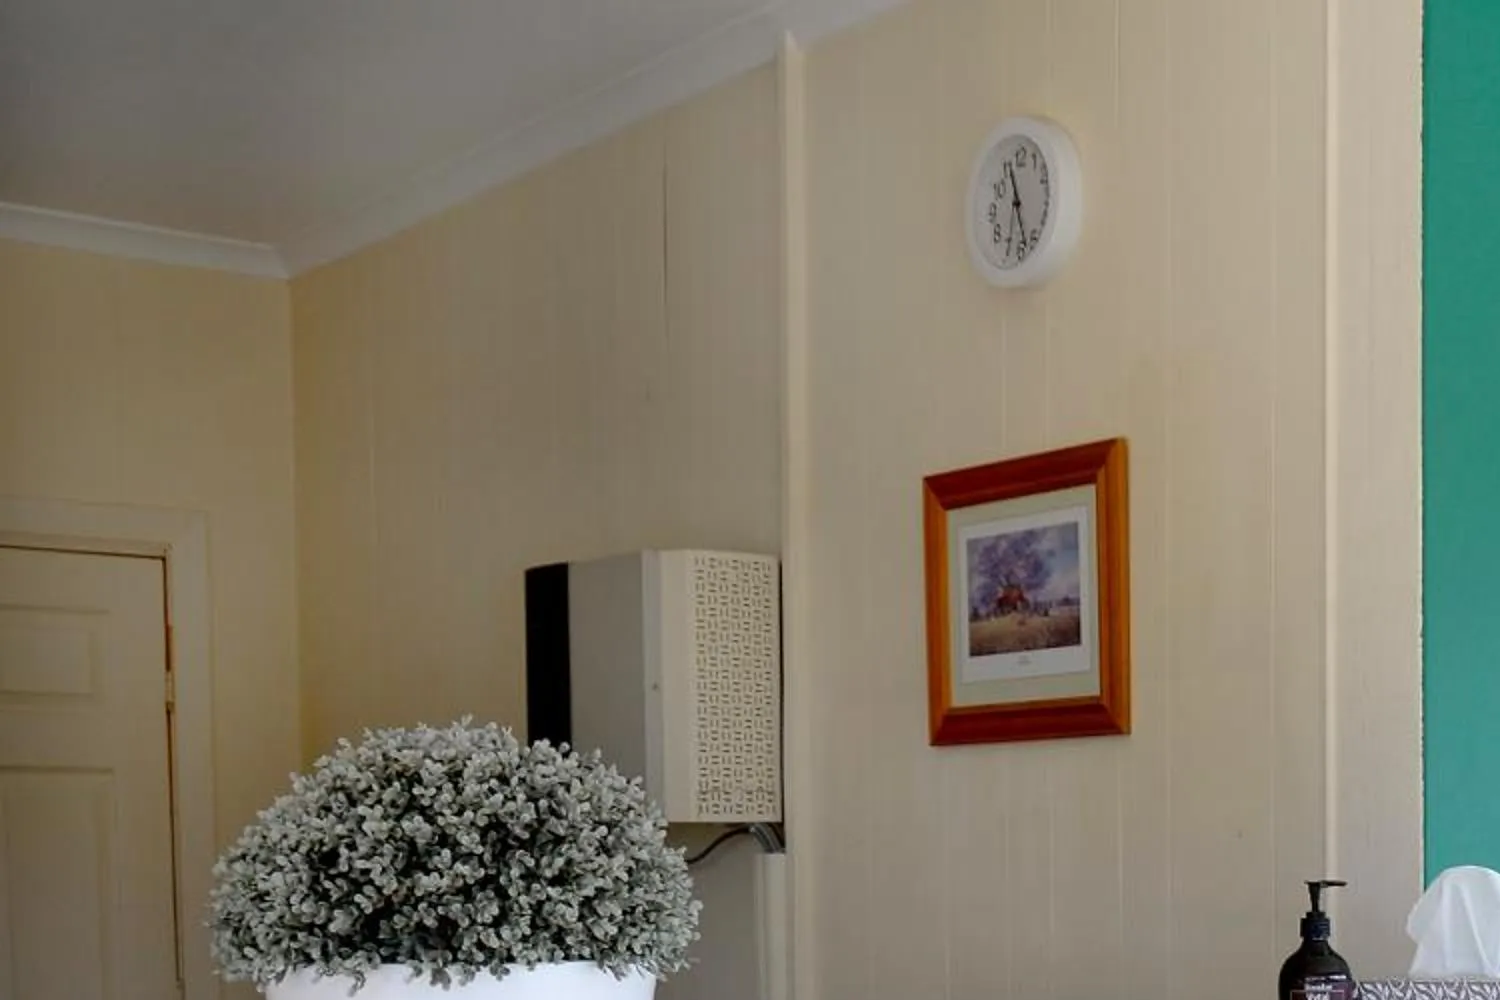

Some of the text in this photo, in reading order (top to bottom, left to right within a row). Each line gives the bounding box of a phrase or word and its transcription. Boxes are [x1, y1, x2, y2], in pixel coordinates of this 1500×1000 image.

[1015, 146, 1027, 168] 12
[1032, 153, 1037, 171] 1
[993, 178, 1006, 199] 10
[988, 202, 997, 223] 9
[993, 223, 1002, 243] 8
